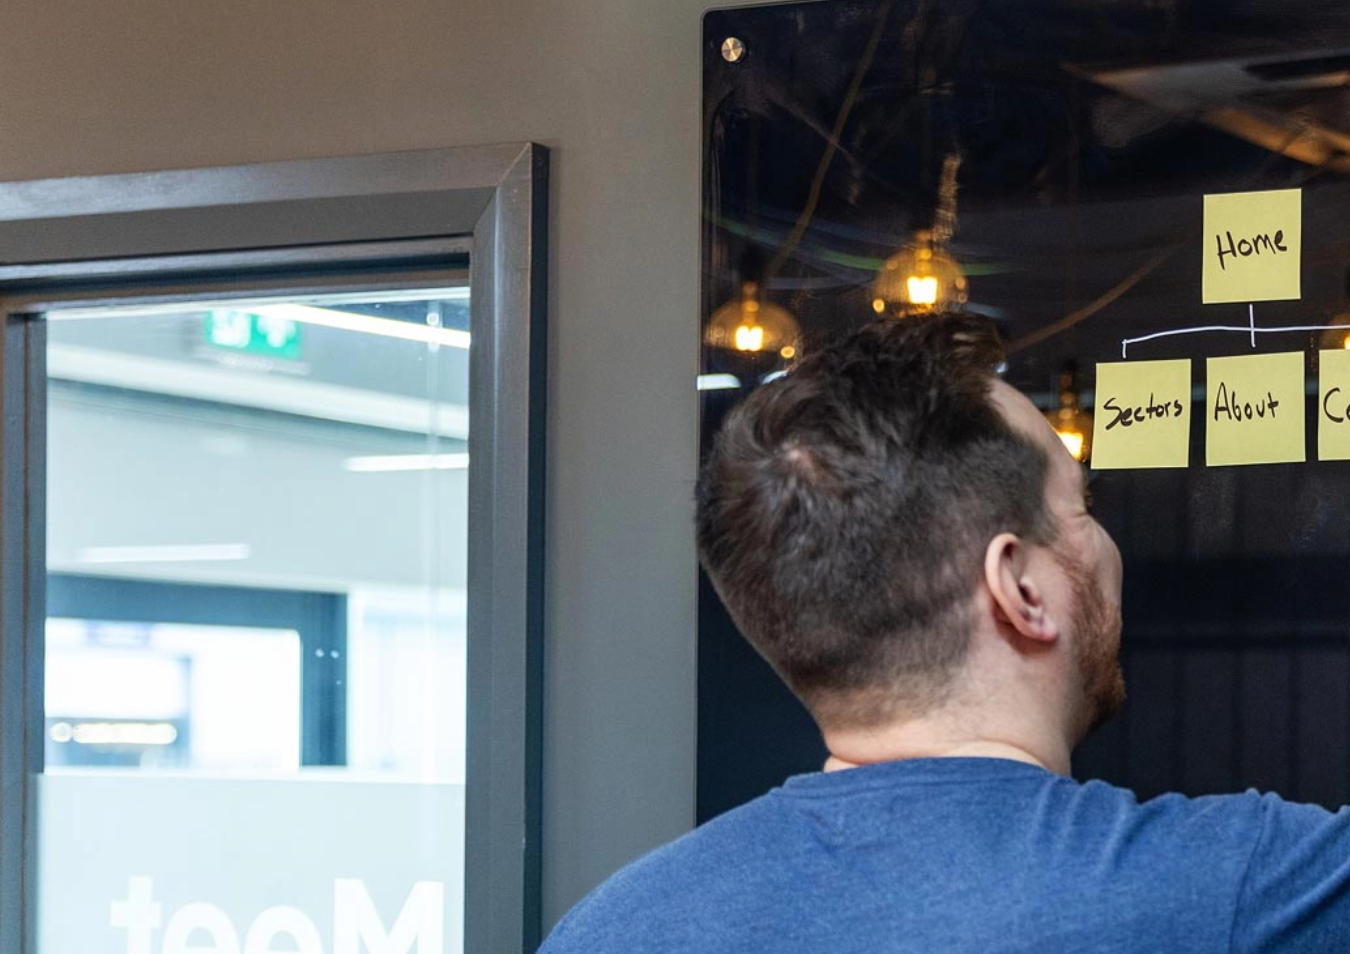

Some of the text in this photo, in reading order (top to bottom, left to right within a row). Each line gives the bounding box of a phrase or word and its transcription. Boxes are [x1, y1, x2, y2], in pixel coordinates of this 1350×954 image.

[1216, 229, 1288, 270] Home
[1103, 393, 1183, 430] Sectors
[1214, 381, 1280, 421] About
